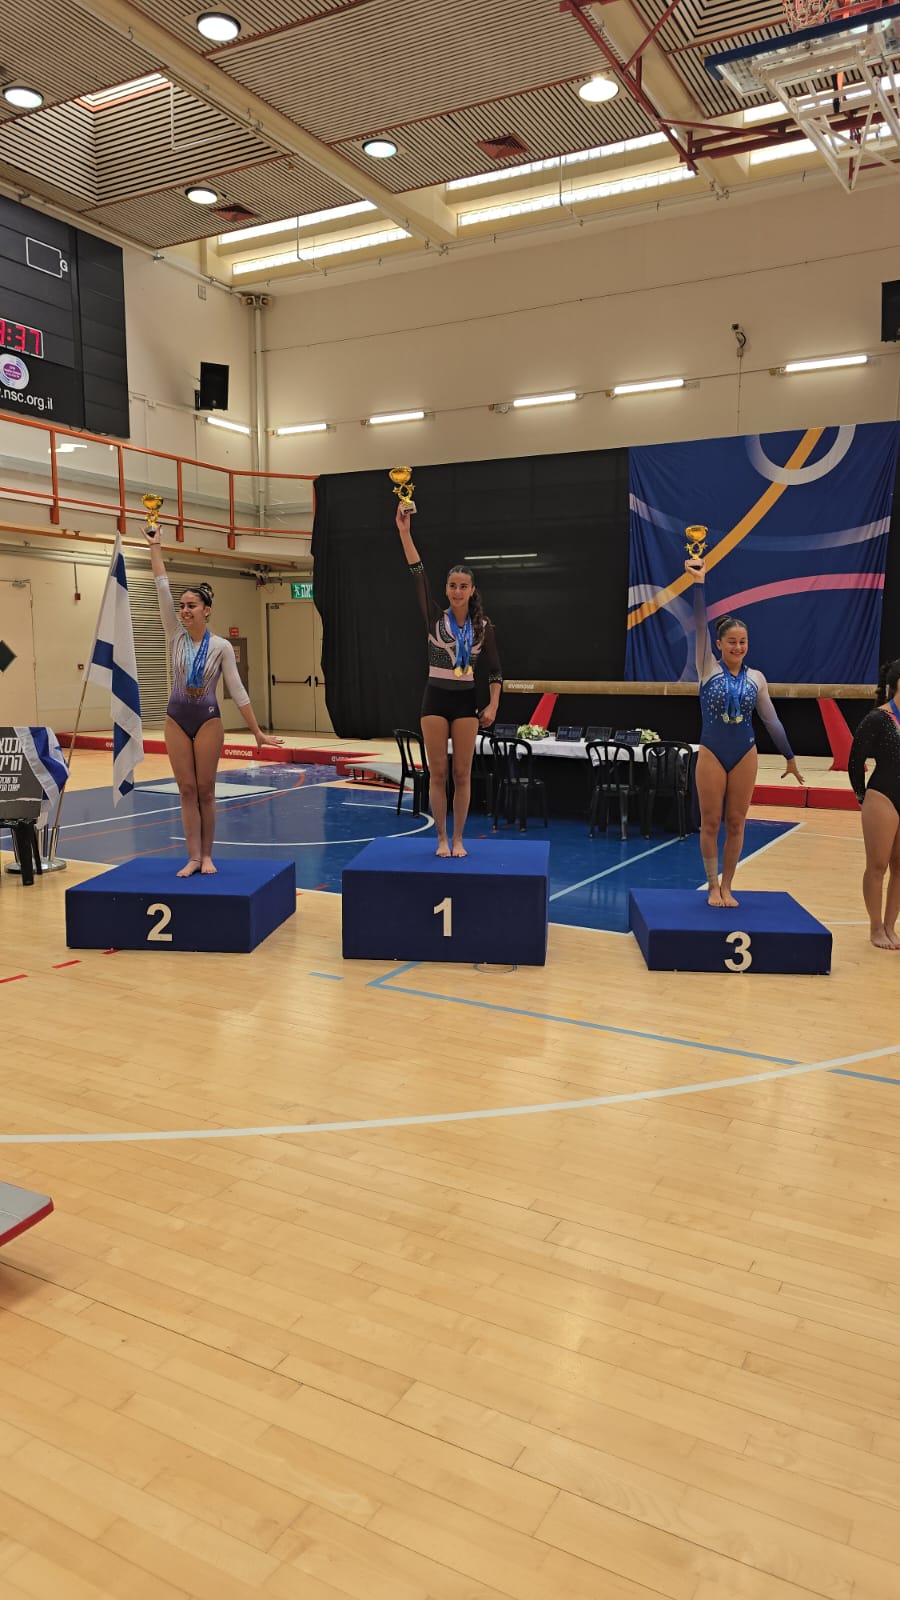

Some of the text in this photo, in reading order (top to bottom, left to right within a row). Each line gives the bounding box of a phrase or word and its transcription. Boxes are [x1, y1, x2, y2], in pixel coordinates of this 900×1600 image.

[0, 387, 53, 411] .nsc.org.il
[146, 903, 173, 942] 2
[433, 897, 453, 937] 1
[724, 931, 753, 972] 3
